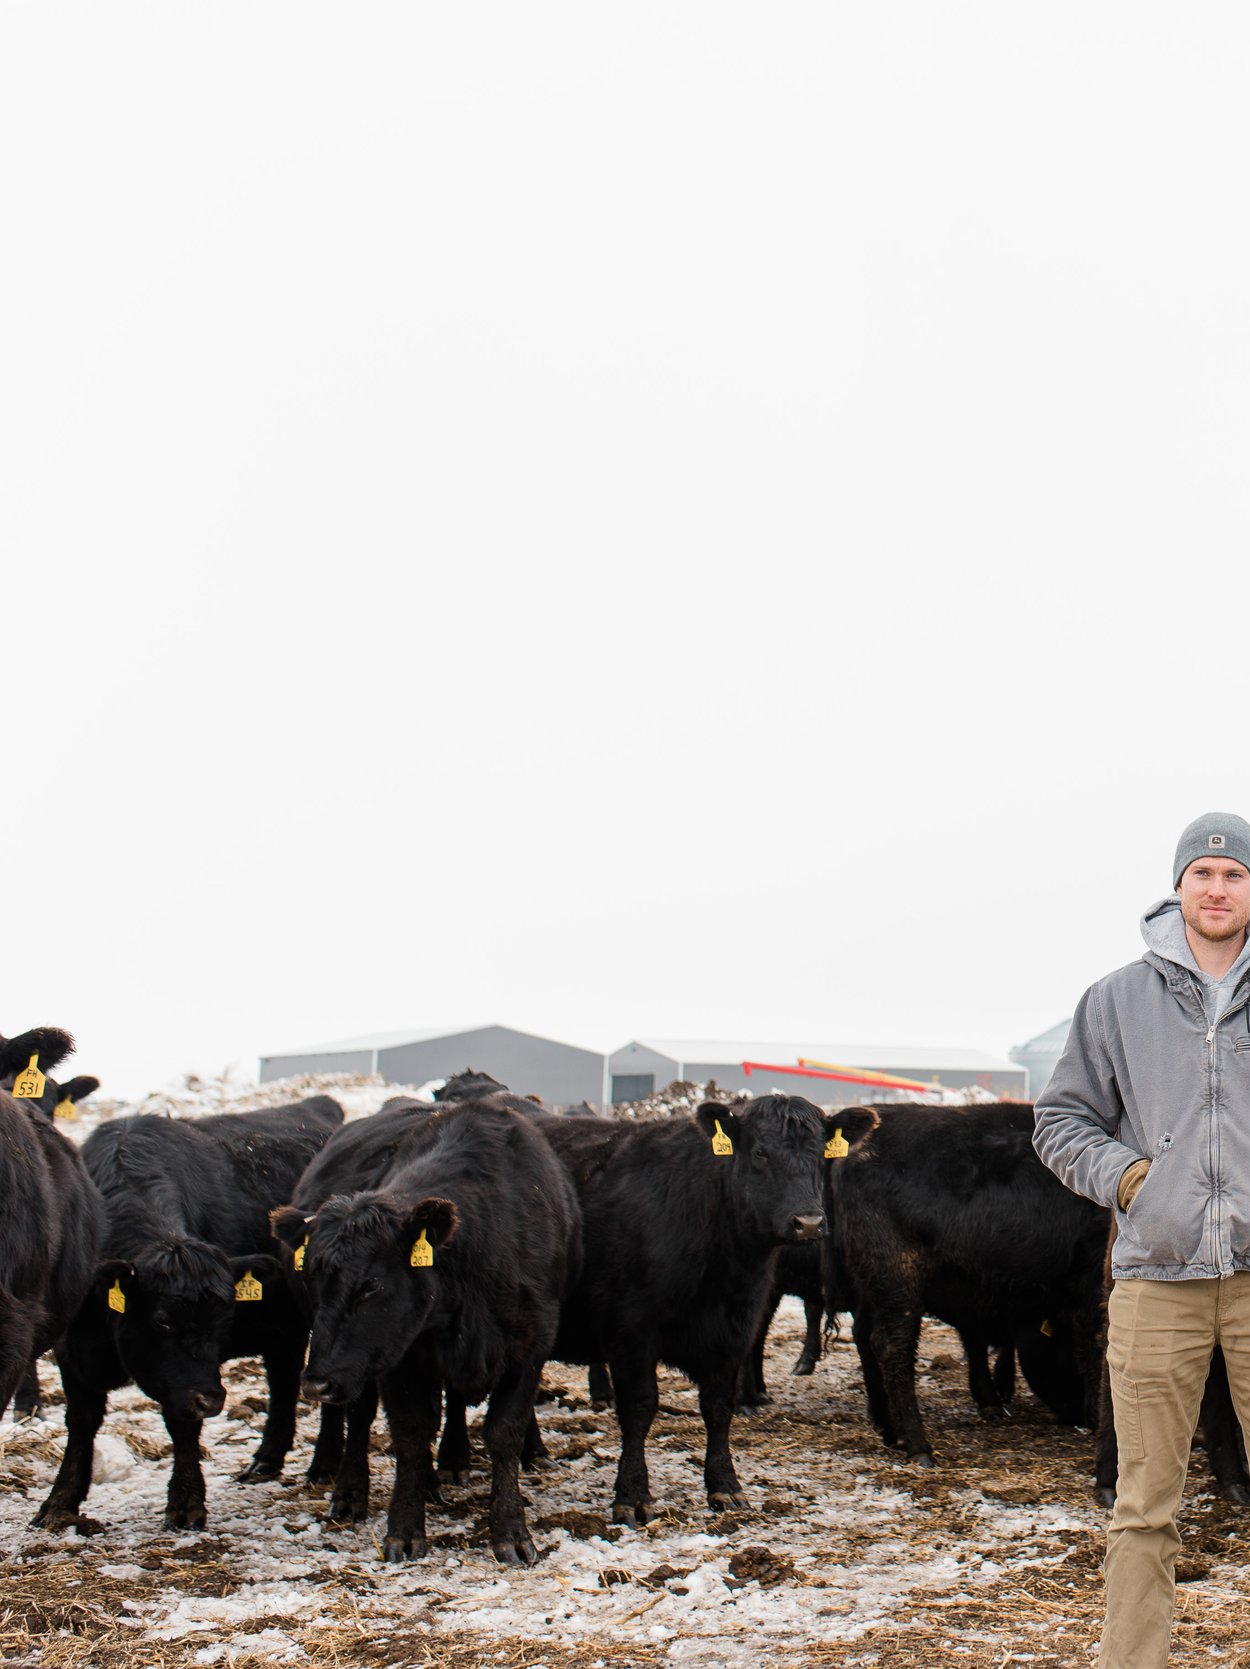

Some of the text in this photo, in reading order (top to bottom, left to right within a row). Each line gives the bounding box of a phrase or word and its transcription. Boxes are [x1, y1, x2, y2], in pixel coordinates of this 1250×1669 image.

[26, 1069, 38, 1078] FH
[18, 1081, 39, 1096] 531
[412, 1255, 429, 1266] 207
[236, 1289, 260, 1299] 545
